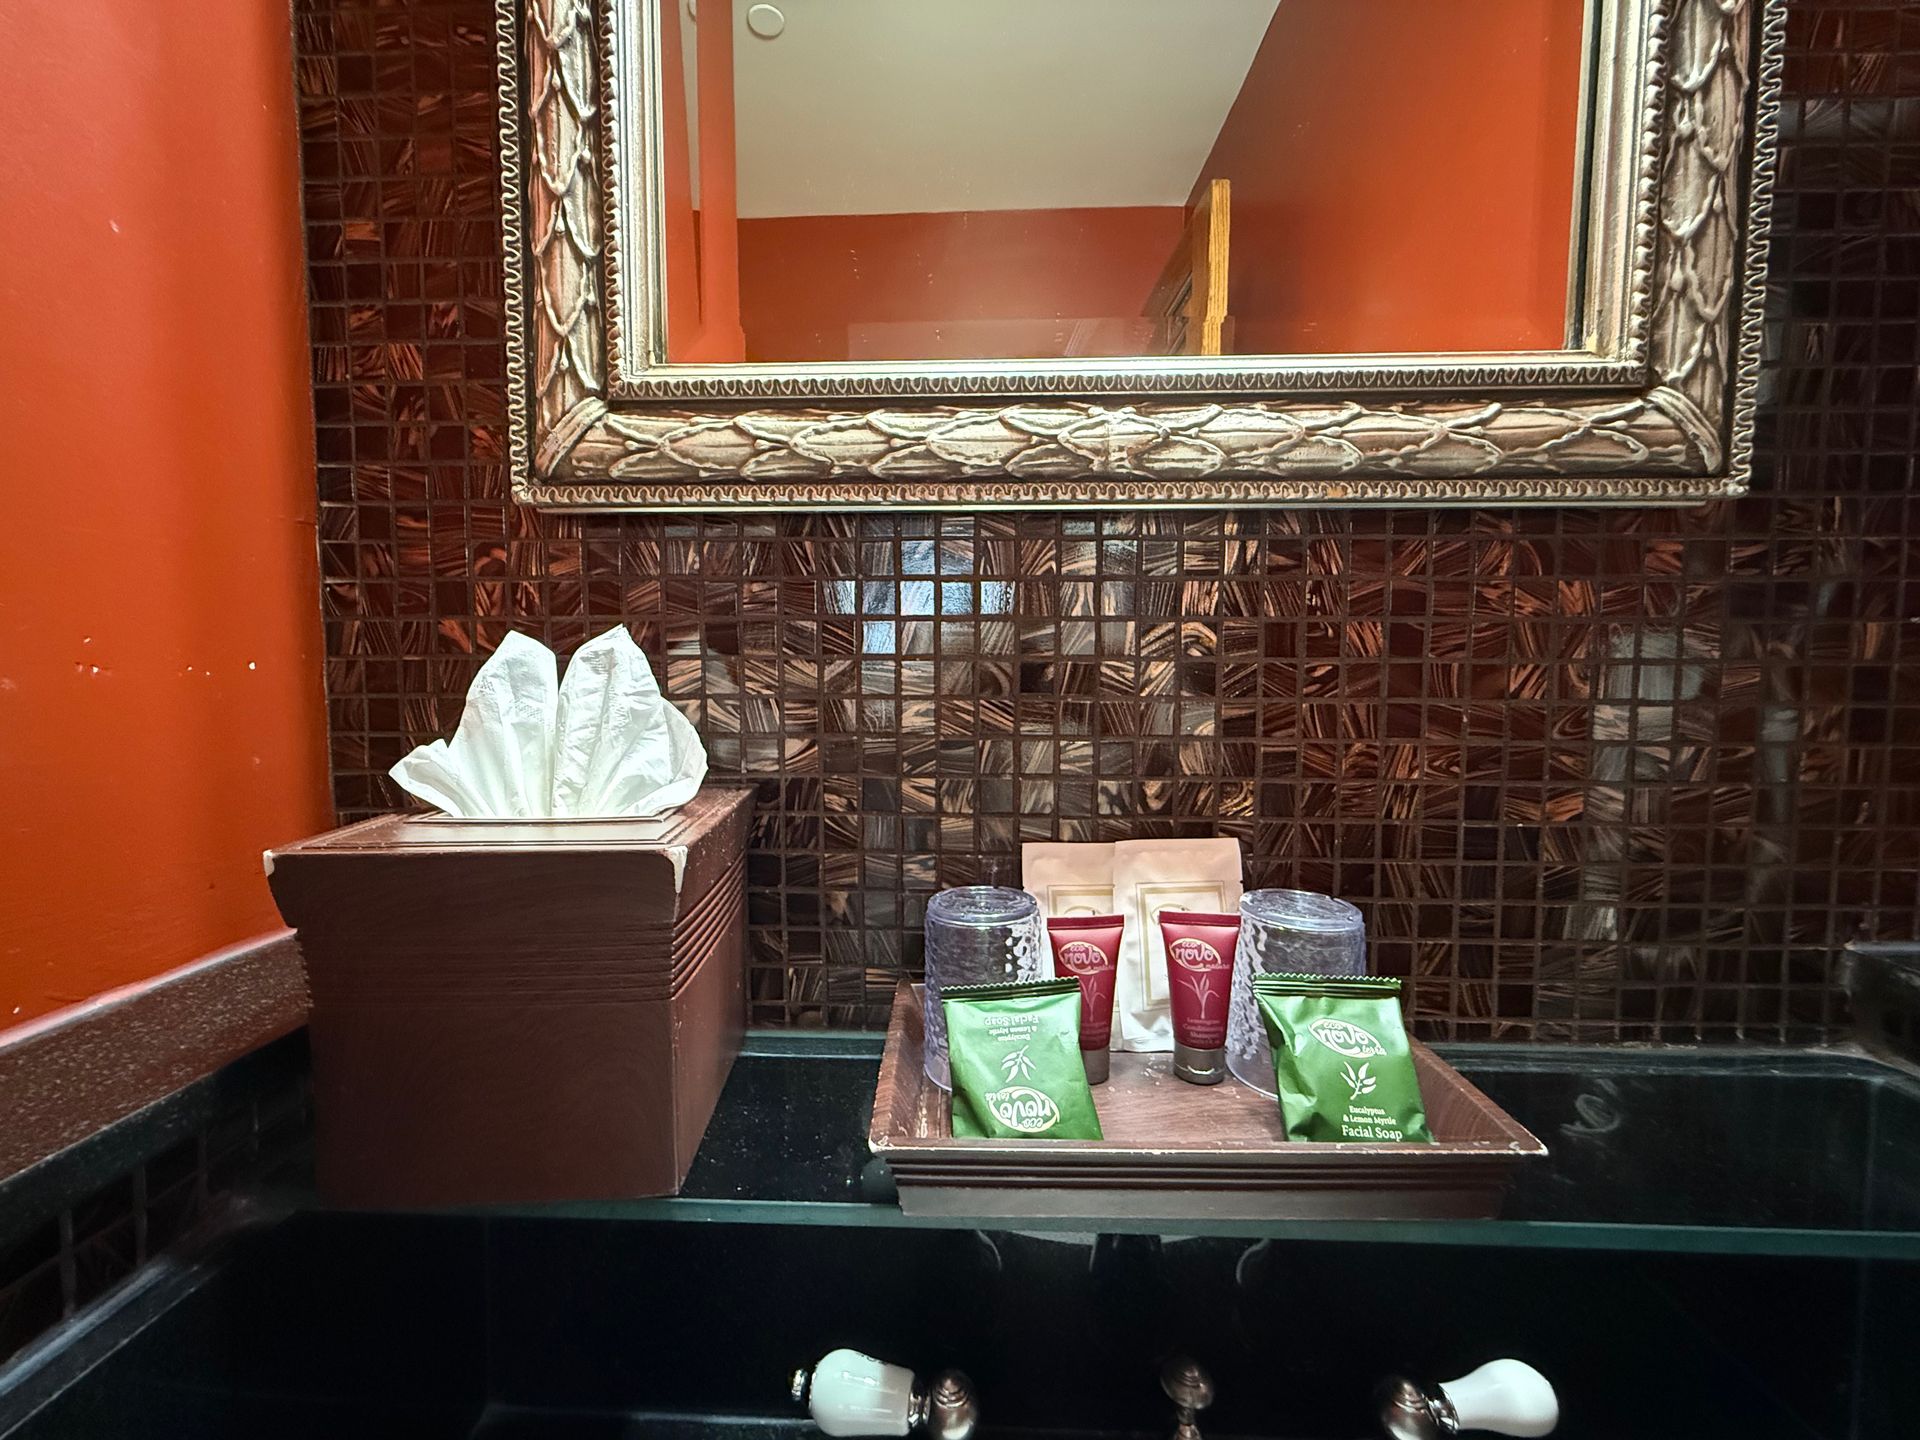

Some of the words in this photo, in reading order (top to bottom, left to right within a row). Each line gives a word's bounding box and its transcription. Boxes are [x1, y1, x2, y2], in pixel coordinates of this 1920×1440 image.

[1064, 946, 1100, 972] novo
[1175, 943, 1213, 969] novo
[984, 1015, 1010, 1026] Soap
[1011, 1014, 1040, 1025] Facial
[1323, 1021, 1343, 1030] eco
[1317, 1024, 1369, 1055] novo
[999, 1089, 1052, 1127] novo
[1349, 1105, 1385, 1116] Eucalyptus
[1022, 1117, 1044, 1128] eco
[1343, 1114, 1349, 1122] &
[1350, 1115, 1373, 1123] Lemon
[1374, 1117, 1397, 1126] Myrtle
[1341, 1125, 1374, 1138] Facial
[1375, 1127, 1403, 1142] Soap
